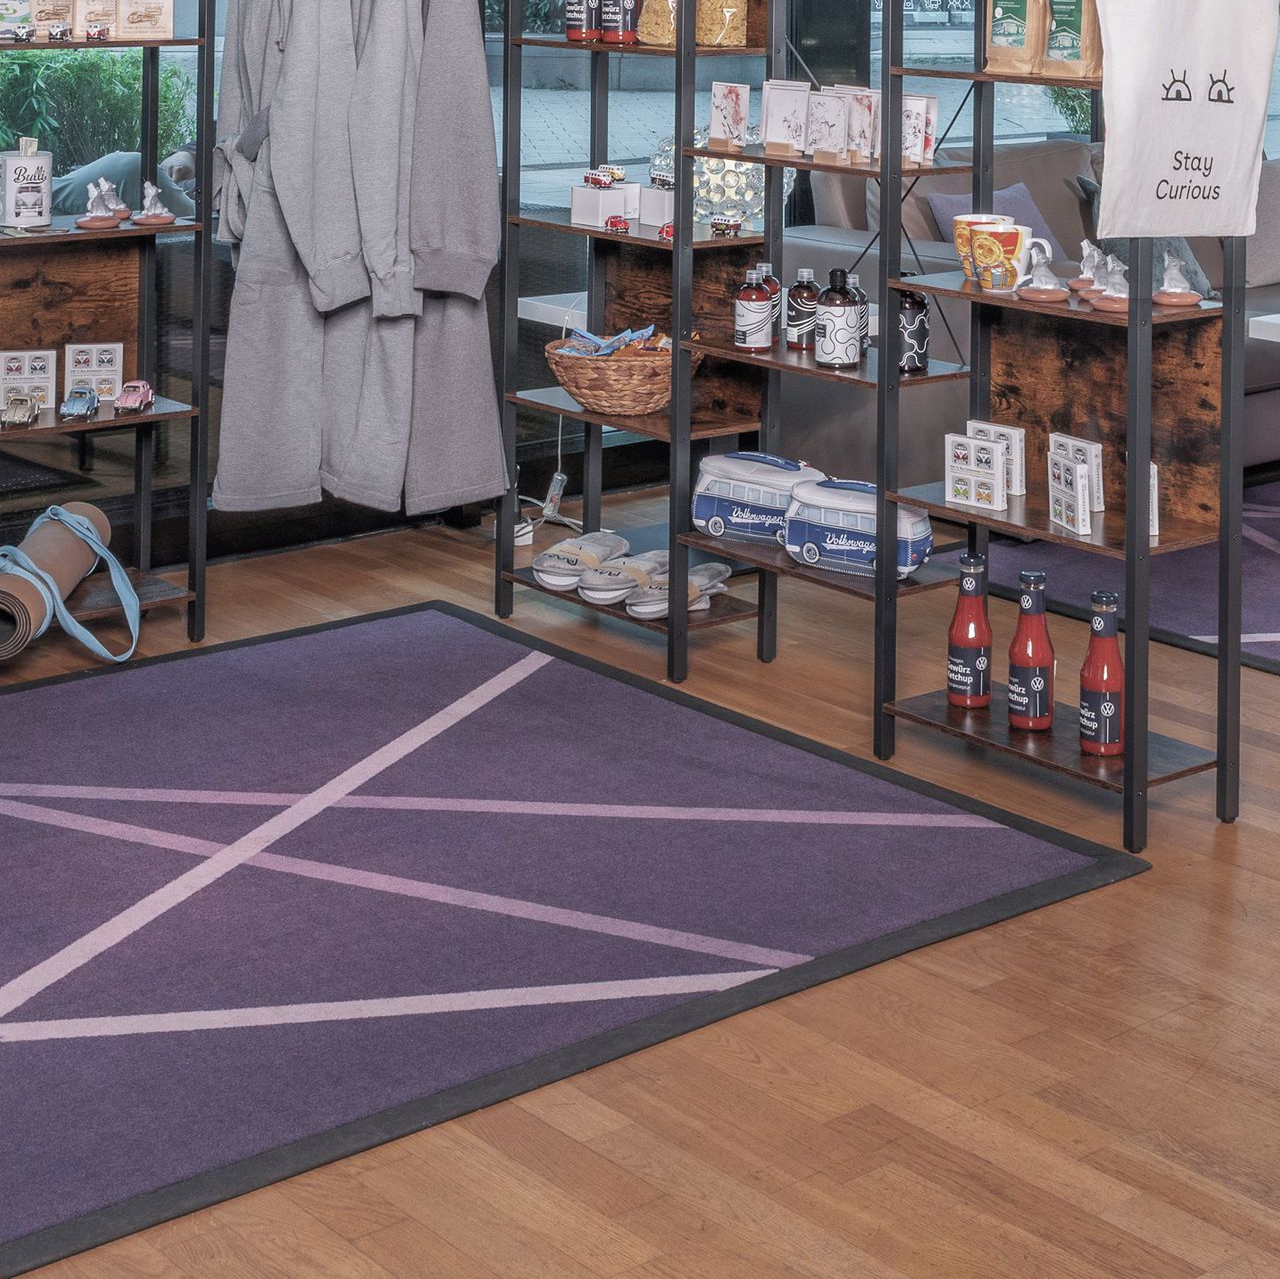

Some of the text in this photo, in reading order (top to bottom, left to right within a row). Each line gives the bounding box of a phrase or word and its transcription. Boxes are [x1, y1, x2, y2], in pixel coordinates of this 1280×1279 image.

[1173, 150, 1214, 177] Stay
[13, 166, 47, 183] Bulli
[1156, 179, 1221, 200] Curious
[824, 532, 876, 553] Volkswage
